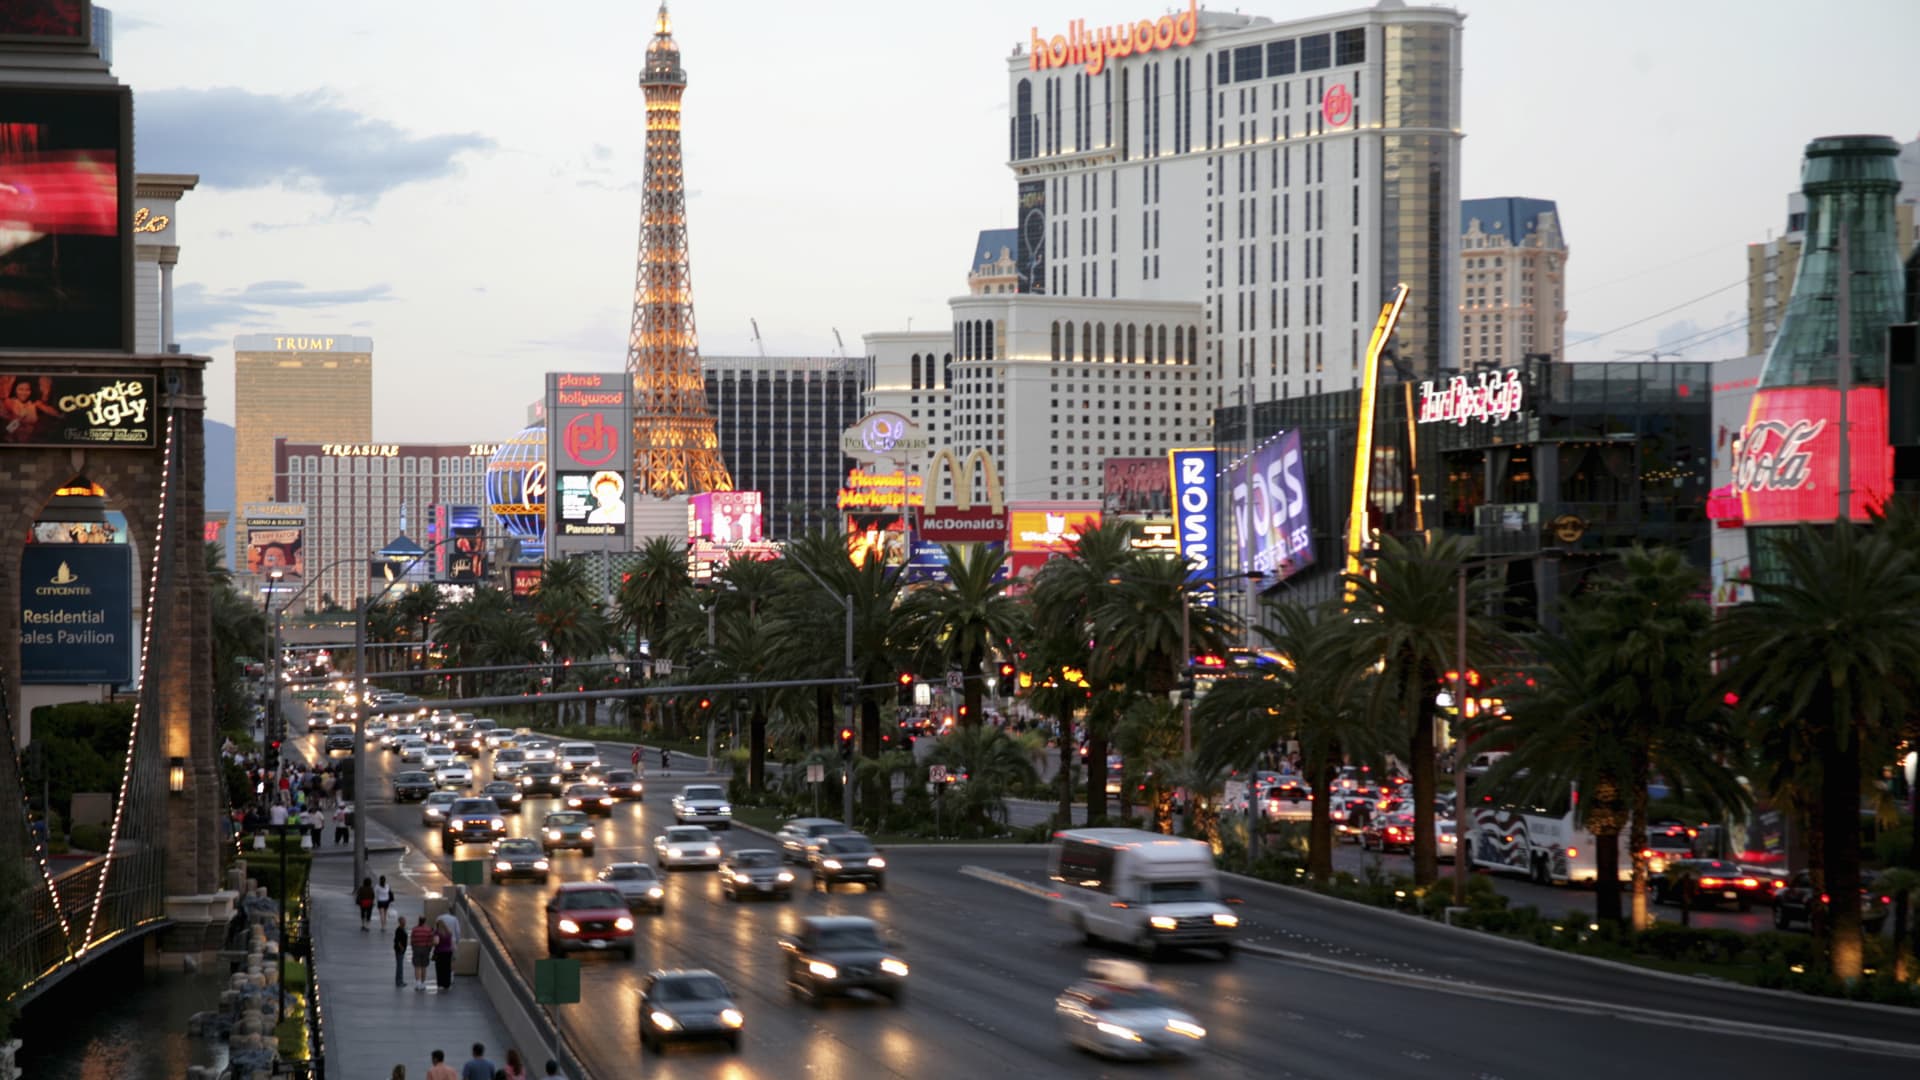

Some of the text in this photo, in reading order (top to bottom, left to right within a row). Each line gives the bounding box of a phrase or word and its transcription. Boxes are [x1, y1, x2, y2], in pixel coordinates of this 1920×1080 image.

[1029, 0, 1197, 75] hollywood
[275, 337, 333, 350] TRUMP
[559, 374, 602, 390] planet
[58, 380, 144, 413] coyote
[559, 391, 624, 407] hollywood
[86, 398, 147, 426] ugly
[321, 444, 502, 457] TREASURE ISLA
[1738, 418, 1826, 492] Cola
[1182, 457, 1208, 571] ROSS
[923, 518, 1004, 530] McDonald's
[36, 586, 92, 595] CITYCENTER
[24, 609, 105, 624] Residential
[57, 630, 115, 645] Pavilion
